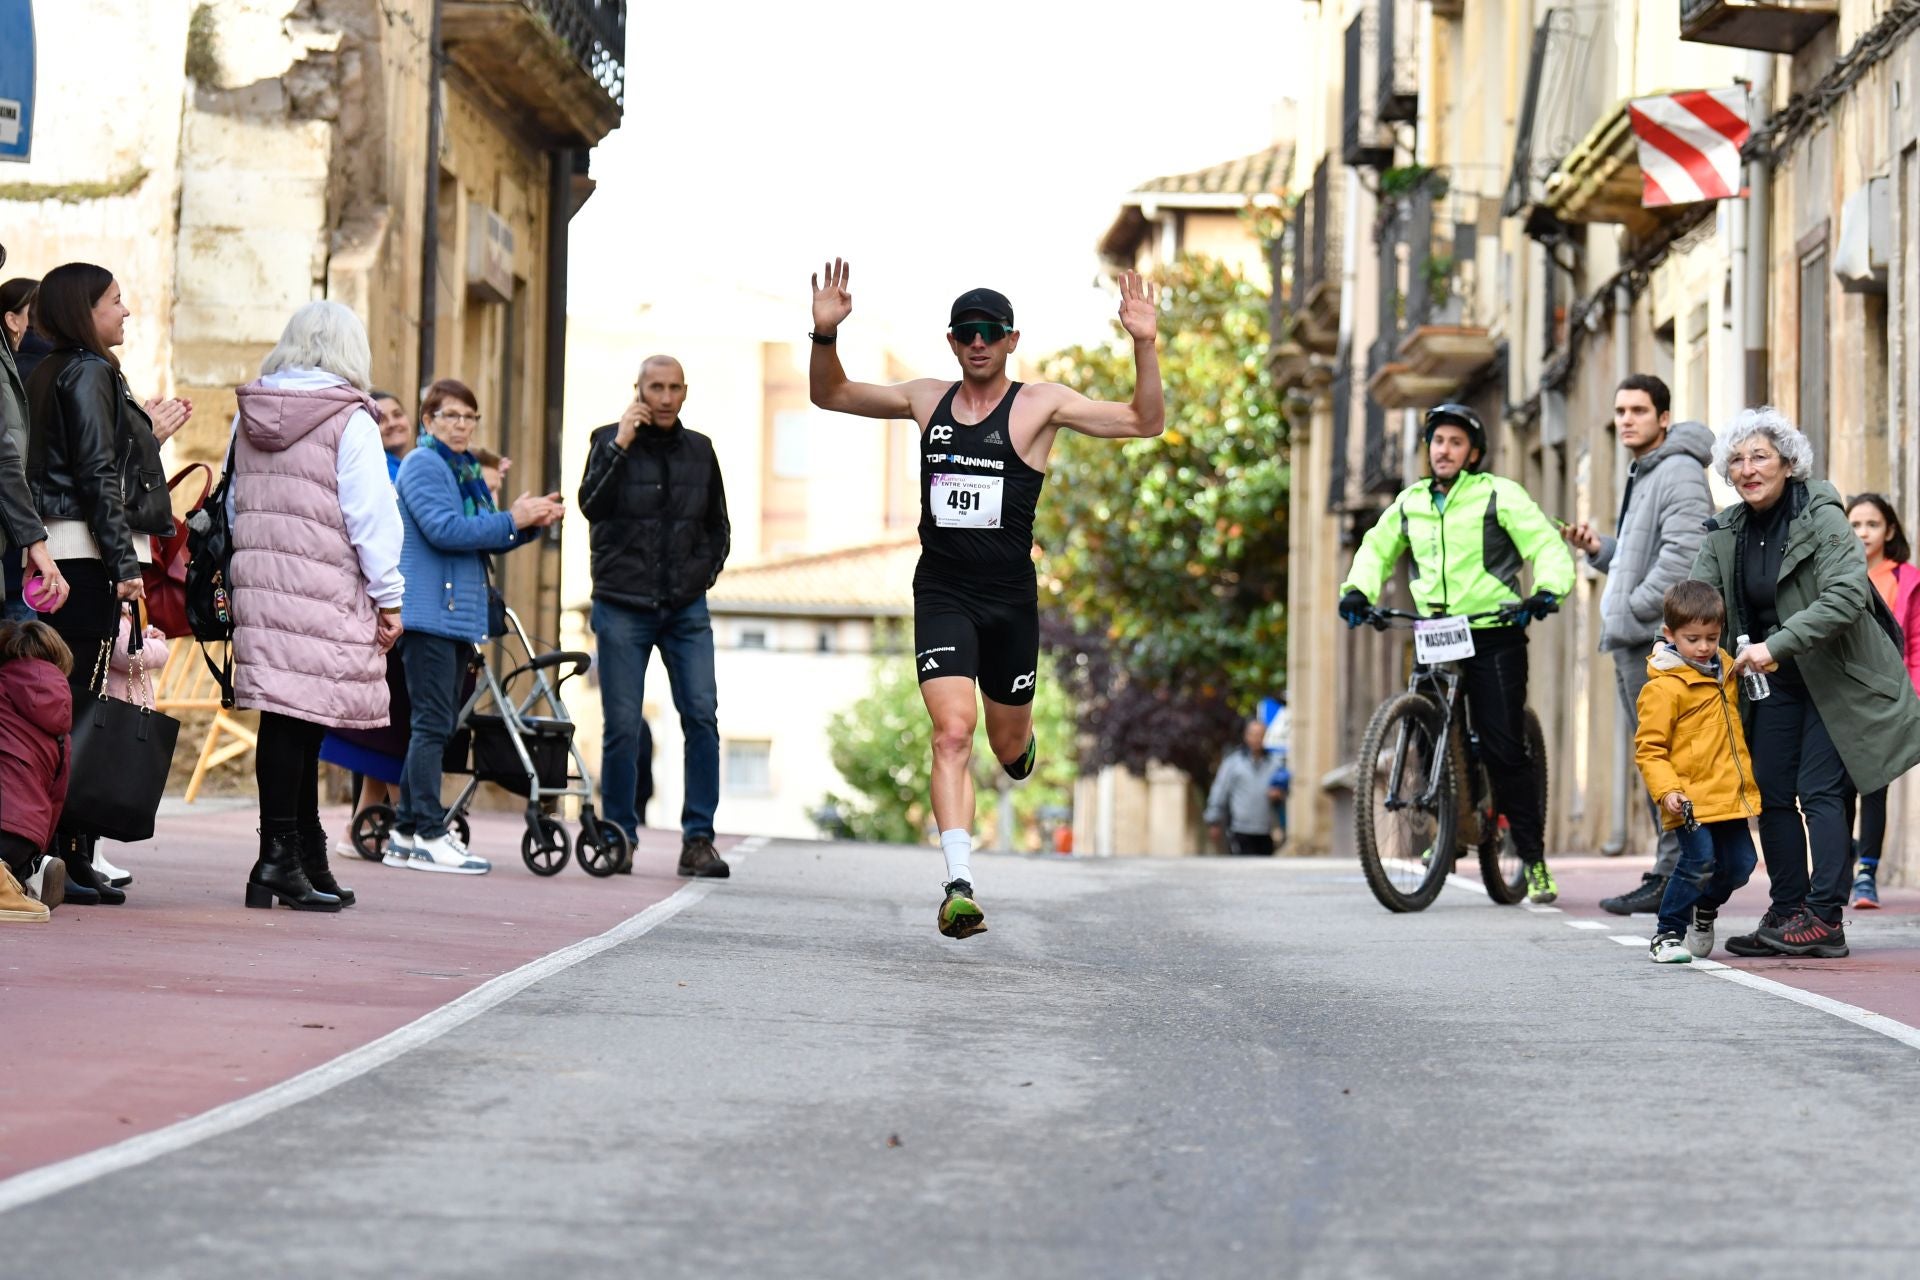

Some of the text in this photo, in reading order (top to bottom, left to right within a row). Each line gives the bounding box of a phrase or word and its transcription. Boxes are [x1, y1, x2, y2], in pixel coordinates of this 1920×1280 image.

[926, 454, 1004, 470] TOP4RUNNING
[947, 490, 980, 510] 491
[1424, 628, 1468, 647] MASCULINO
